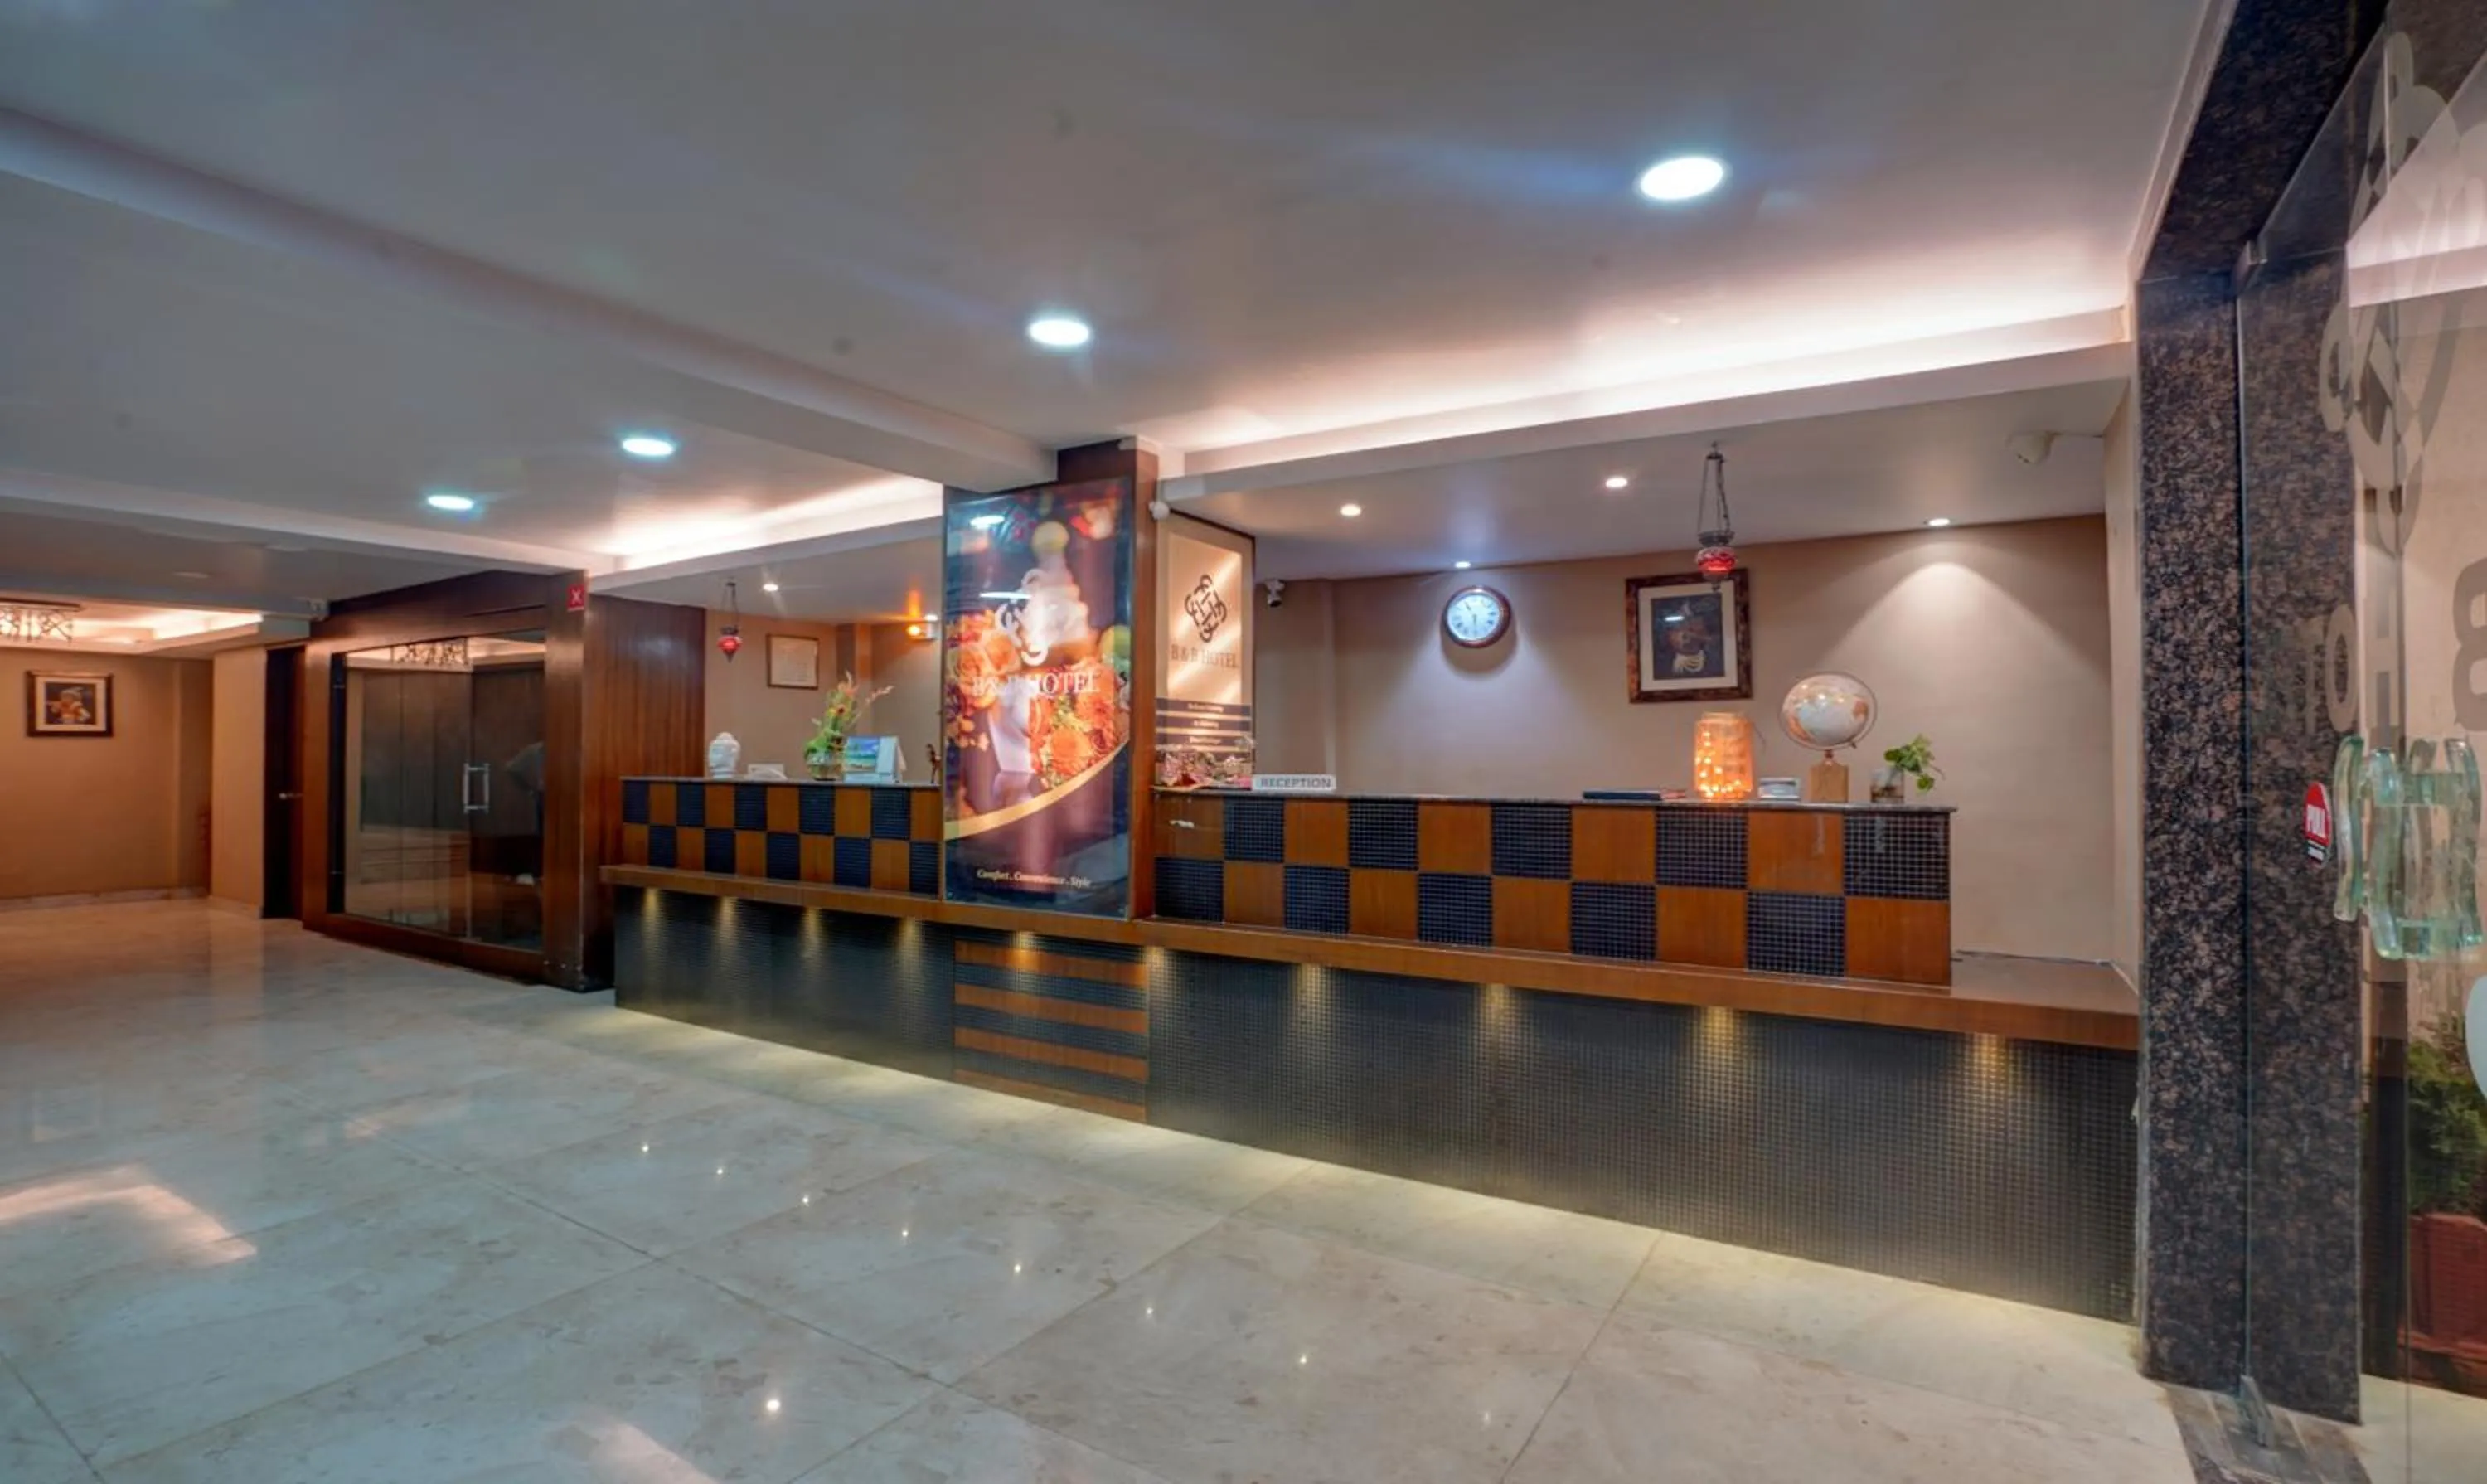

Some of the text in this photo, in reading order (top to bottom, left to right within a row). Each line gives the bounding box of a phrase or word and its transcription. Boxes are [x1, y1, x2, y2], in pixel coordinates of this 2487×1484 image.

[1202, 648, 1239, 668] HOTEL
[1261, 778, 1331, 788] RECEPTION
[2306, 803, 2326, 839] PULL
